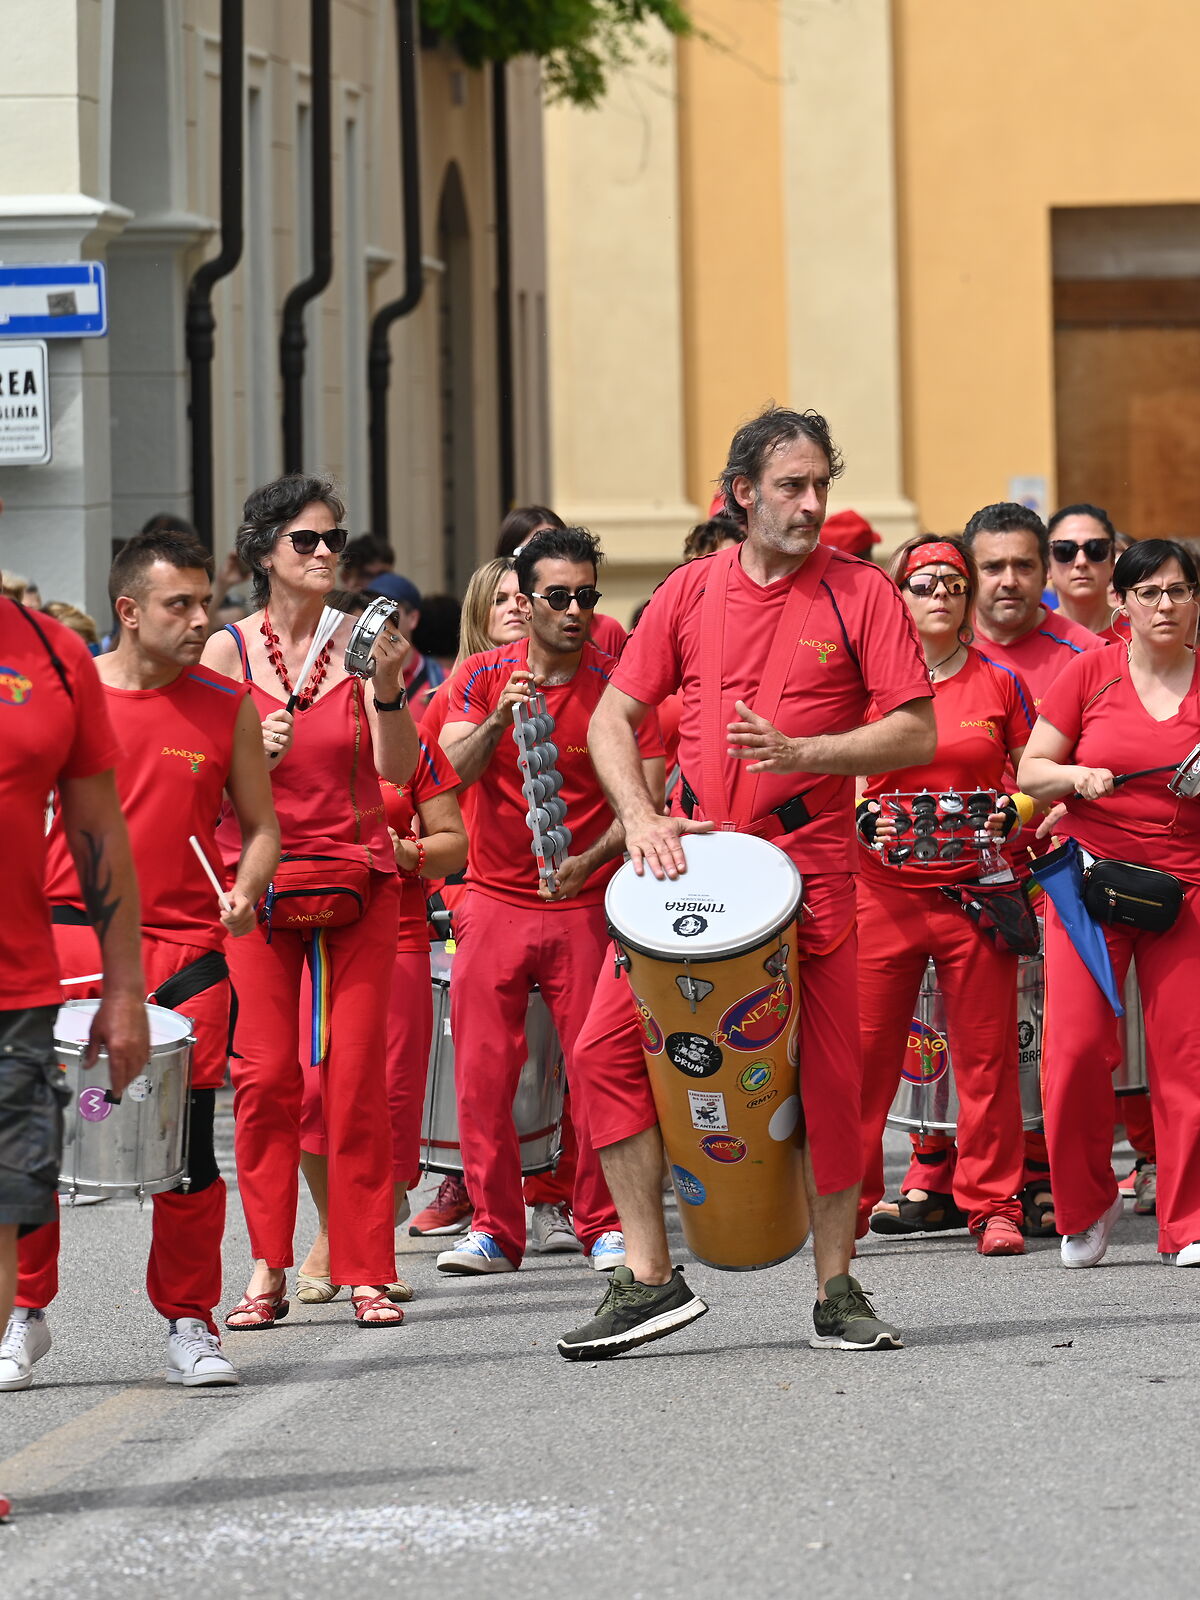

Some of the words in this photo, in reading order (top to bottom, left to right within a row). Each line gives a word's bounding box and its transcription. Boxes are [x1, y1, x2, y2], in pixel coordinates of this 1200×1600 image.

[0, 370, 37, 395] EA
[664, 901, 727, 913] TIMBRA
[674, 1054, 705, 1074] DRUM
